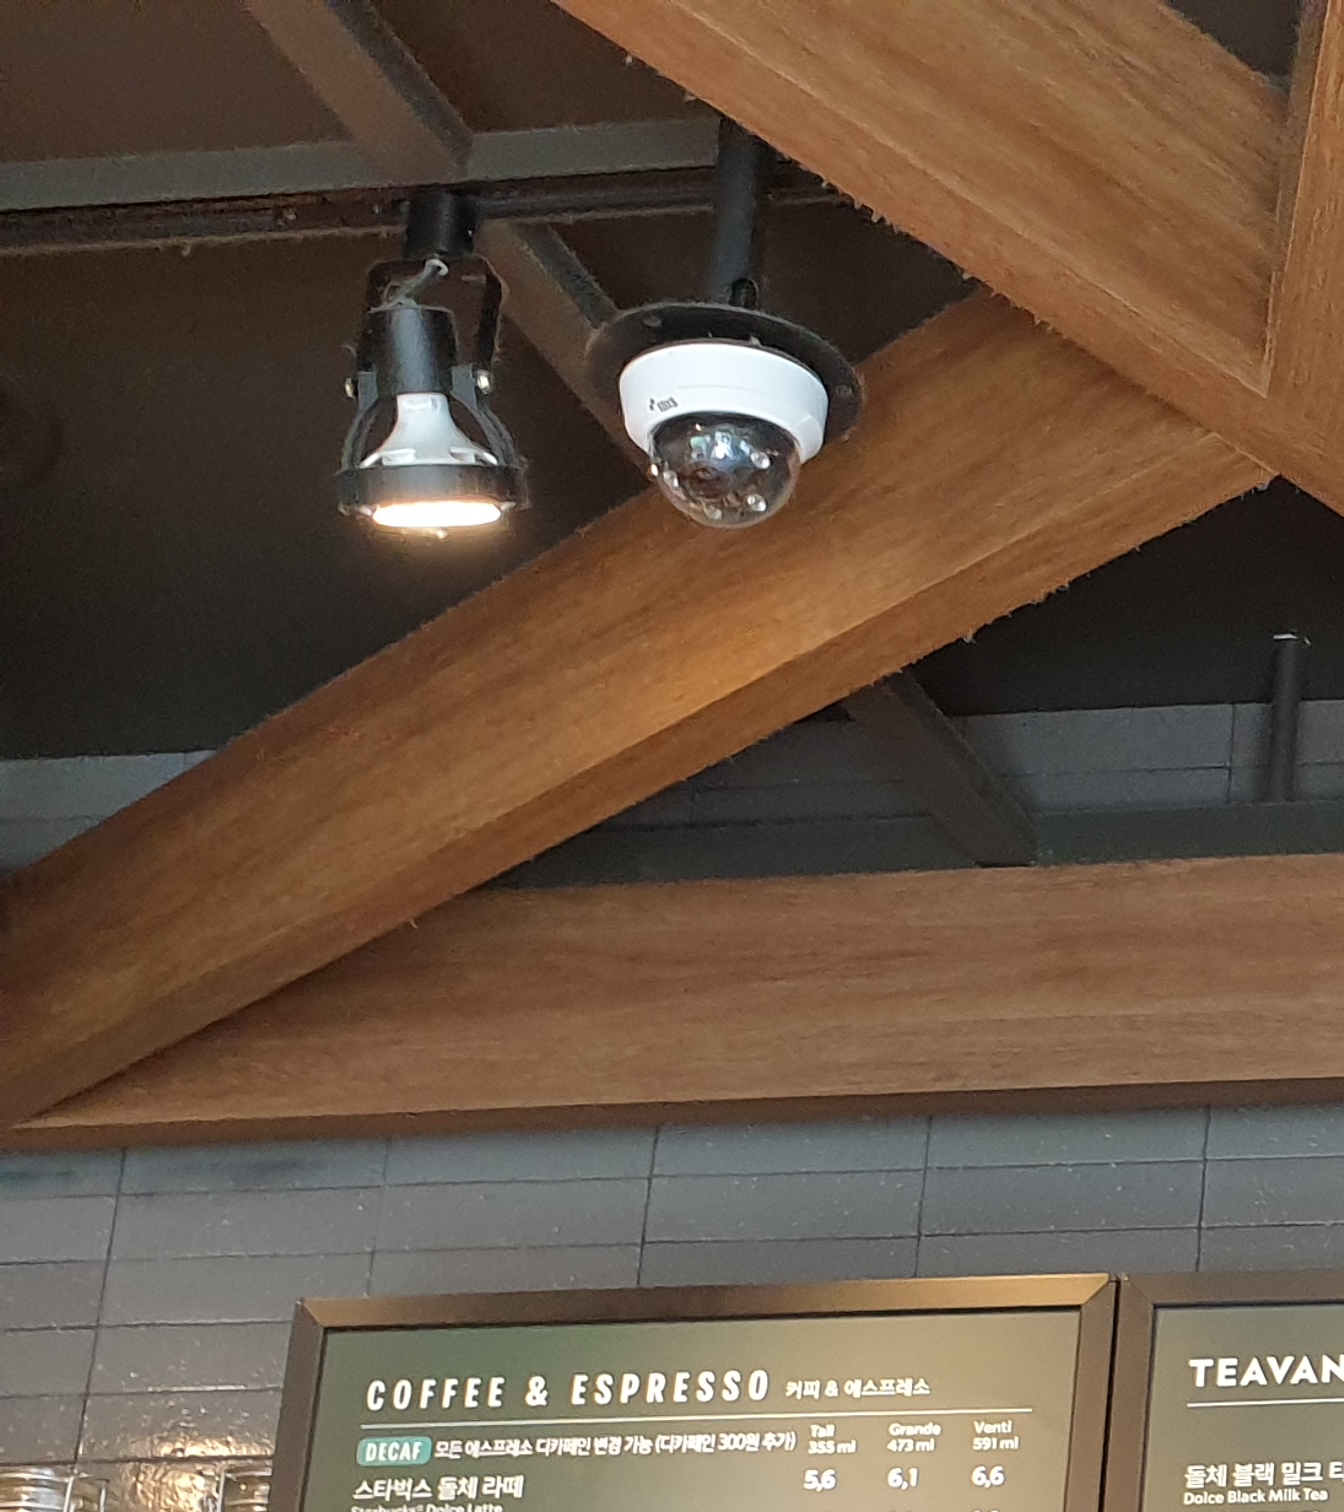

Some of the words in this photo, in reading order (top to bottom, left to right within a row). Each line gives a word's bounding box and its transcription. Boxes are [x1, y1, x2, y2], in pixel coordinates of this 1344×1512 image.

[367, 1377, 505, 1411] COFFEE
[525, 1375, 548, 1407] &
[571, 1369, 768, 1405] ESPRESSO
[785, 1379, 821, 1400] 커피
[824, 1380, 839, 1397] &
[843, 1377, 931, 1399] 에스프레소
[364, 1442, 422, 1464] DECAF
[803, 1469, 836, 1492] 5,6
[887, 1467, 918, 1490] 6,1
[971, 1465, 1005, 1488] 6,6
[1183, 1491, 1225, 1506] Dolce
[1227, 1488, 1266, 1504] Black
[1268, 1488, 1301, 1502] Milk
[1302, 1487, 1328, 1501] Tea
